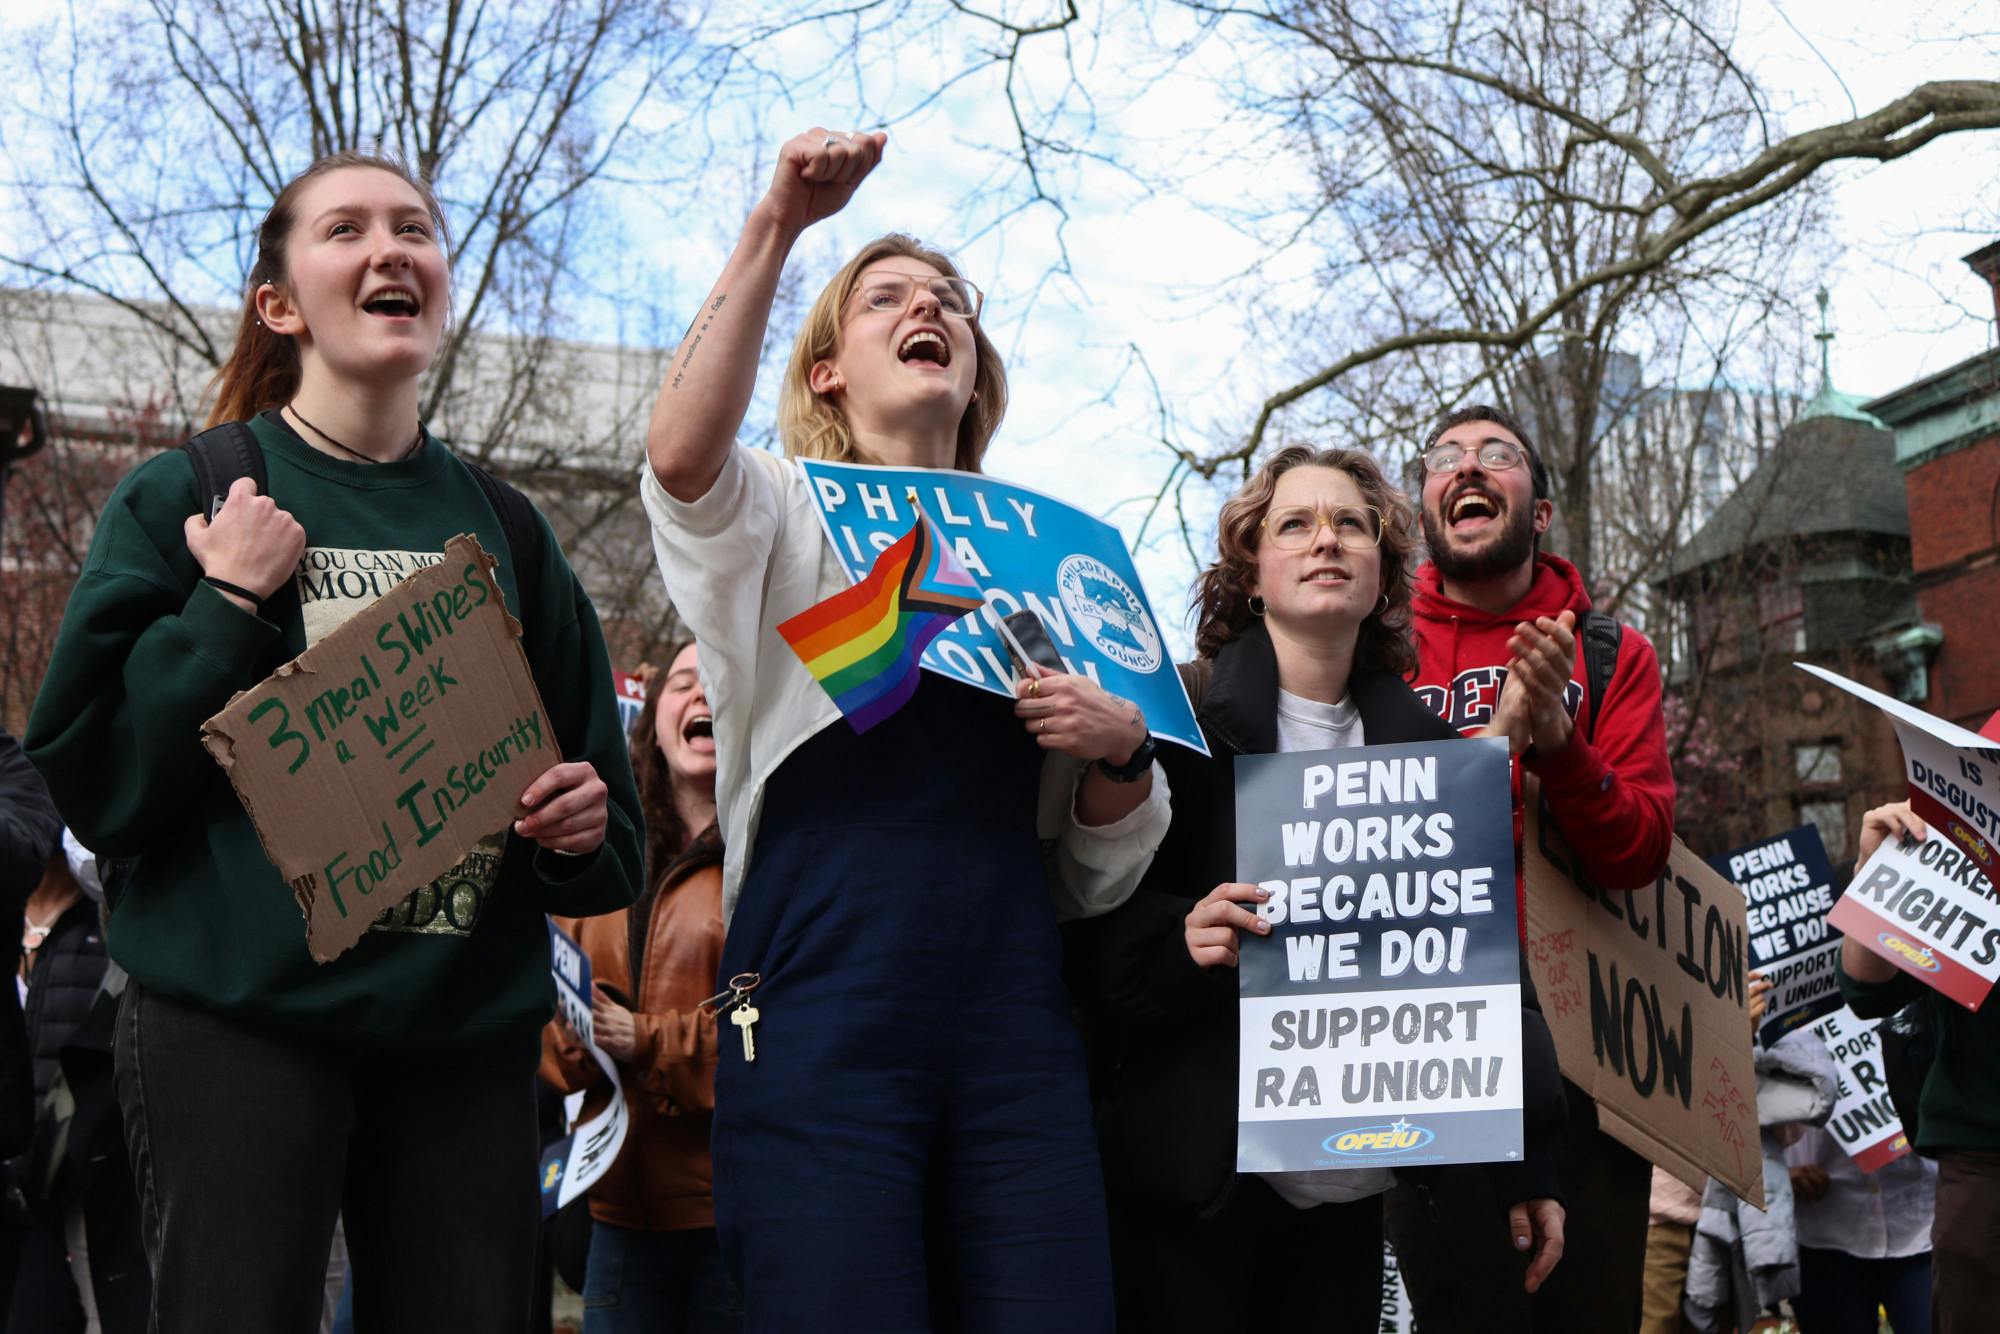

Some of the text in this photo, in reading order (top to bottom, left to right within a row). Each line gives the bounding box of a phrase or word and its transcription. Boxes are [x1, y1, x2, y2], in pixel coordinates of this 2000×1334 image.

[813, 475, 1037, 538] PHILLY
[299, 550, 445, 573] YOU CAN MO
[954, 536, 992, 577] A
[1096, 635, 1155, 668] COUNCIL
[247, 696, 310, 775] 3
[335, 739, 356, 765] a
[1302, 756, 1437, 810] PENN
[1958, 755, 1983, 786] IS
[324, 710, 543, 919] Food Insecurity
[1912, 759, 2000, 846] DISGUST
[1281, 812, 1455, 867] WORKS
[1729, 838, 1795, 881] PENN
[1256, 866, 1494, 926] BECAUSE
[1747, 883, 1834, 935] ECAUSE
[1857, 863, 2000, 966] RIGHTS
[1285, 926, 1468, 982] WE DO!
[1751, 928, 1791, 962] WE
[1884, 936, 1936, 968] OPEIU
[1269, 999, 1487, 1051] SUPPORT
[1587, 948, 1693, 1111] NOW
[1254, 1055, 1503, 1108] RA UNION!
[1335, 1131, 1421, 1151] OPEIU
